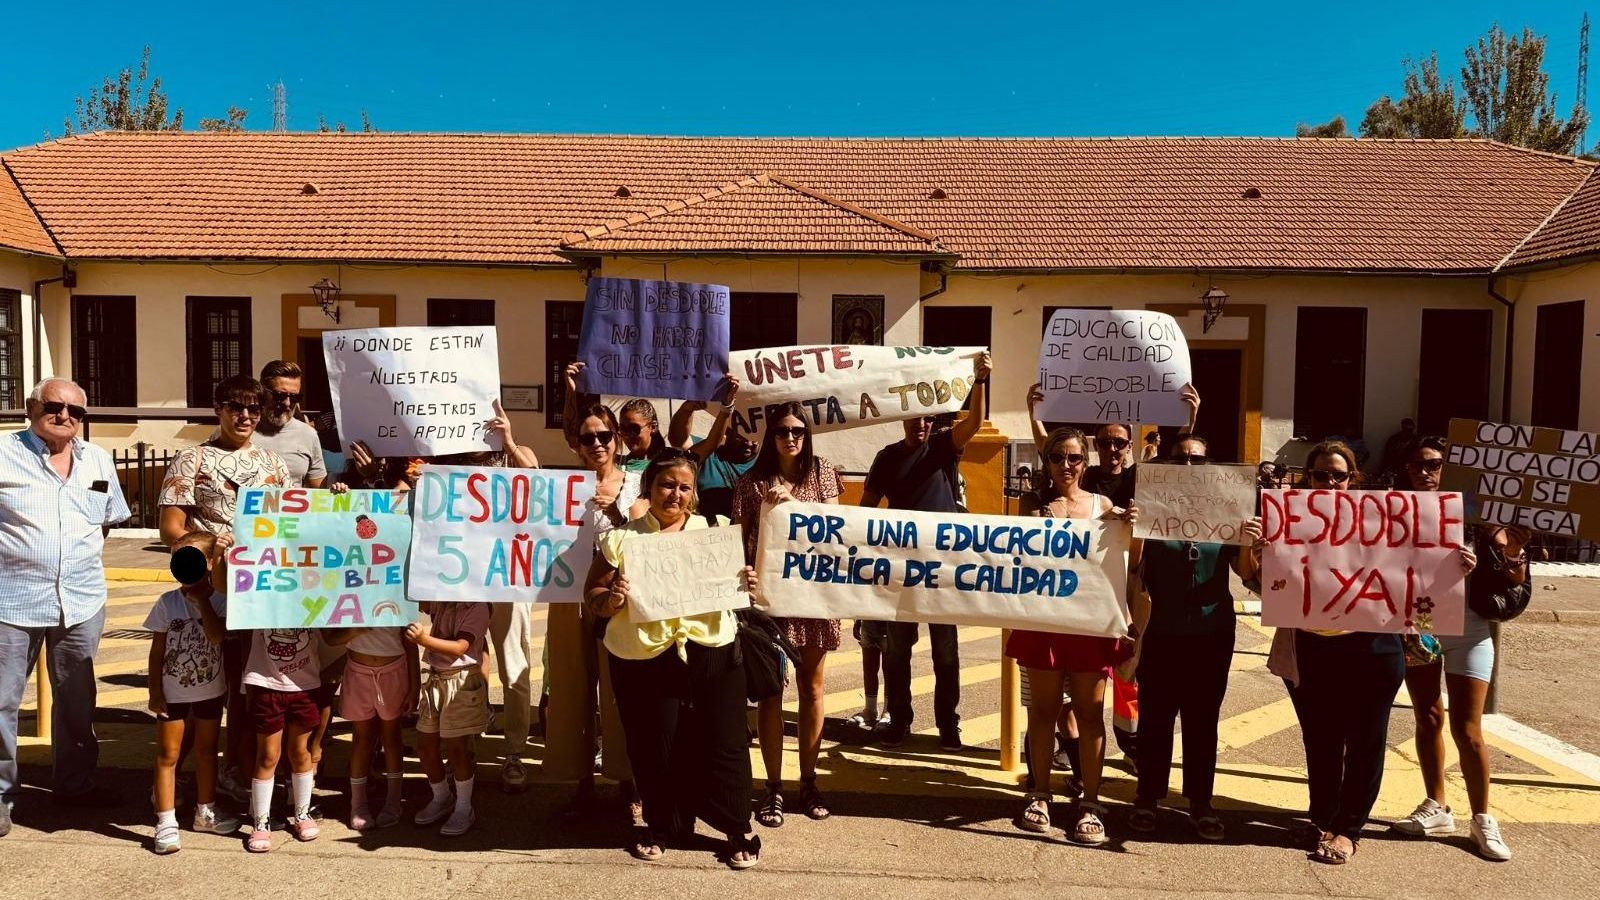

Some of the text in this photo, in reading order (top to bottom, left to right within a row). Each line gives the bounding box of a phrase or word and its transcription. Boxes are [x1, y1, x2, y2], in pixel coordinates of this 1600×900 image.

[591, 288, 636, 312] SIN
[429, 333, 484, 351] ESTAN
[611, 323, 640, 345] NO
[1051, 315, 1177, 341] EDUCACIÓN
[597, 353, 672, 380] CLASE
[744, 345, 864, 386] ÚNETE,
[1046, 343, 1173, 363] DE CALIDAD
[370, 367, 458, 385] NUESTROS
[393, 400, 477, 416] MAESTROS
[731, 395, 847, 434] AFTA
[859, 392, 881, 420] A
[1094, 399, 1141, 422] YA!!
[378, 425, 398, 438] DE
[1476, 422, 1593, 456] CON LA
[421, 472, 585, 527] DESDOBLE
[1477, 473, 1569, 505] NO SE
[253, 516, 300, 539] DE
[1261, 490, 1462, 549] DESDOBLE
[1482, 501, 1577, 535] JUEGA
[788, 512, 1091, 560] POR UNA EDUCACIÓN
[228, 543, 396, 568] CALIDAD
[437, 532, 575, 588] 5 AÑOS
[644, 549, 733, 577] NO HAY
[234, 565, 402, 593] DESDOBLE
[782, 546, 1079, 598] PÚBLICA DE CALIDAD
[301, 593, 365, 626] YA
